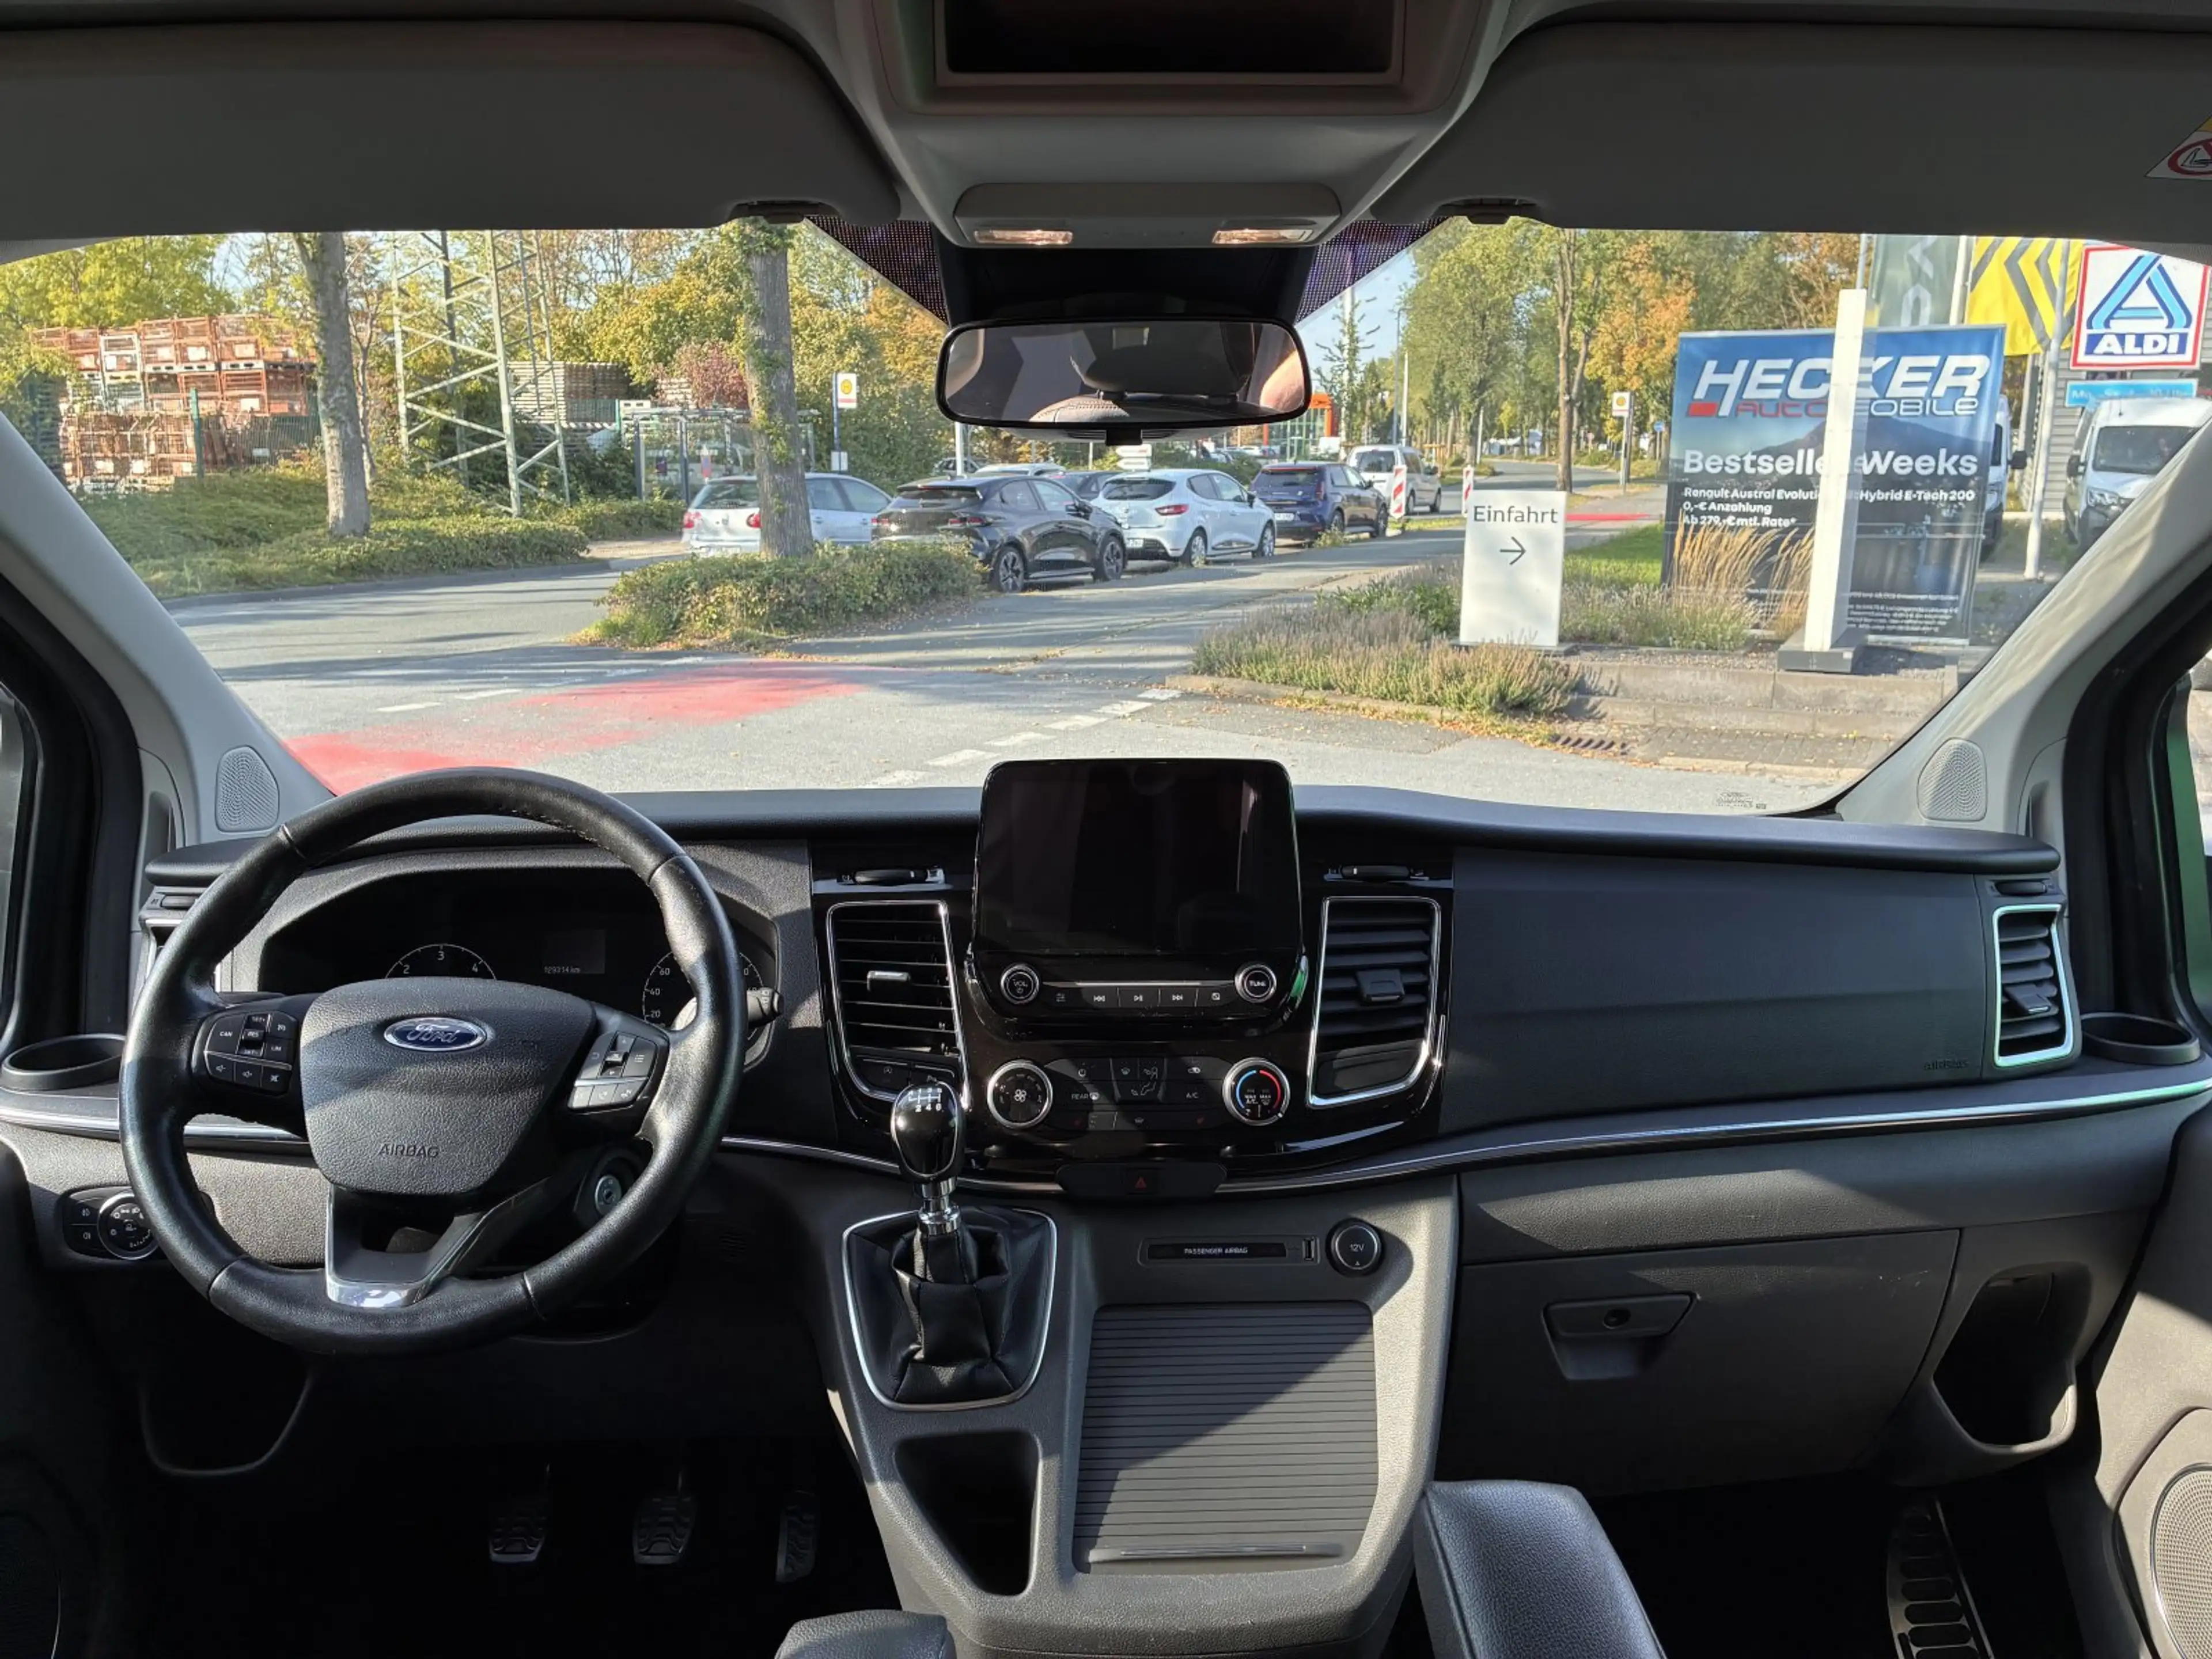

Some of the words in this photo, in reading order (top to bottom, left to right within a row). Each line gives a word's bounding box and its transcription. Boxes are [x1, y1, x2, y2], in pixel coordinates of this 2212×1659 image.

[2093, 334, 2180, 354] ALDI
[1736, 398, 1979, 417] AUTOOBILE
[1684, 448, 1825, 475] Bestsell
[1862, 448, 1978, 475] Weeks
[1684, 487, 1729, 498] Renault
[1730, 488, 1775, 499] Austral
[1777, 489, 1819, 500] Evoluti
[1859, 490, 1902, 503] Hybrid
[1904, 490, 1949, 501] E-Tech
[1949, 491, 1975, 501] 200
[1473, 505, 1559, 523] Einfahrt
[1707, 502, 1772, 514] Anzahlung
[403, 964, 410, 974] 2
[438, 951, 445, 960] 3
[472, 963, 478, 972] 4
[660, 968, 670, 976] 60
[650, 987, 660, 995] 40
[651, 1010, 661, 1018] 20
[406, 1023, 460, 1043] Ford
[378, 1143, 439, 1158] AIRBAG
[1350, 1244, 1365, 1252] 12V
